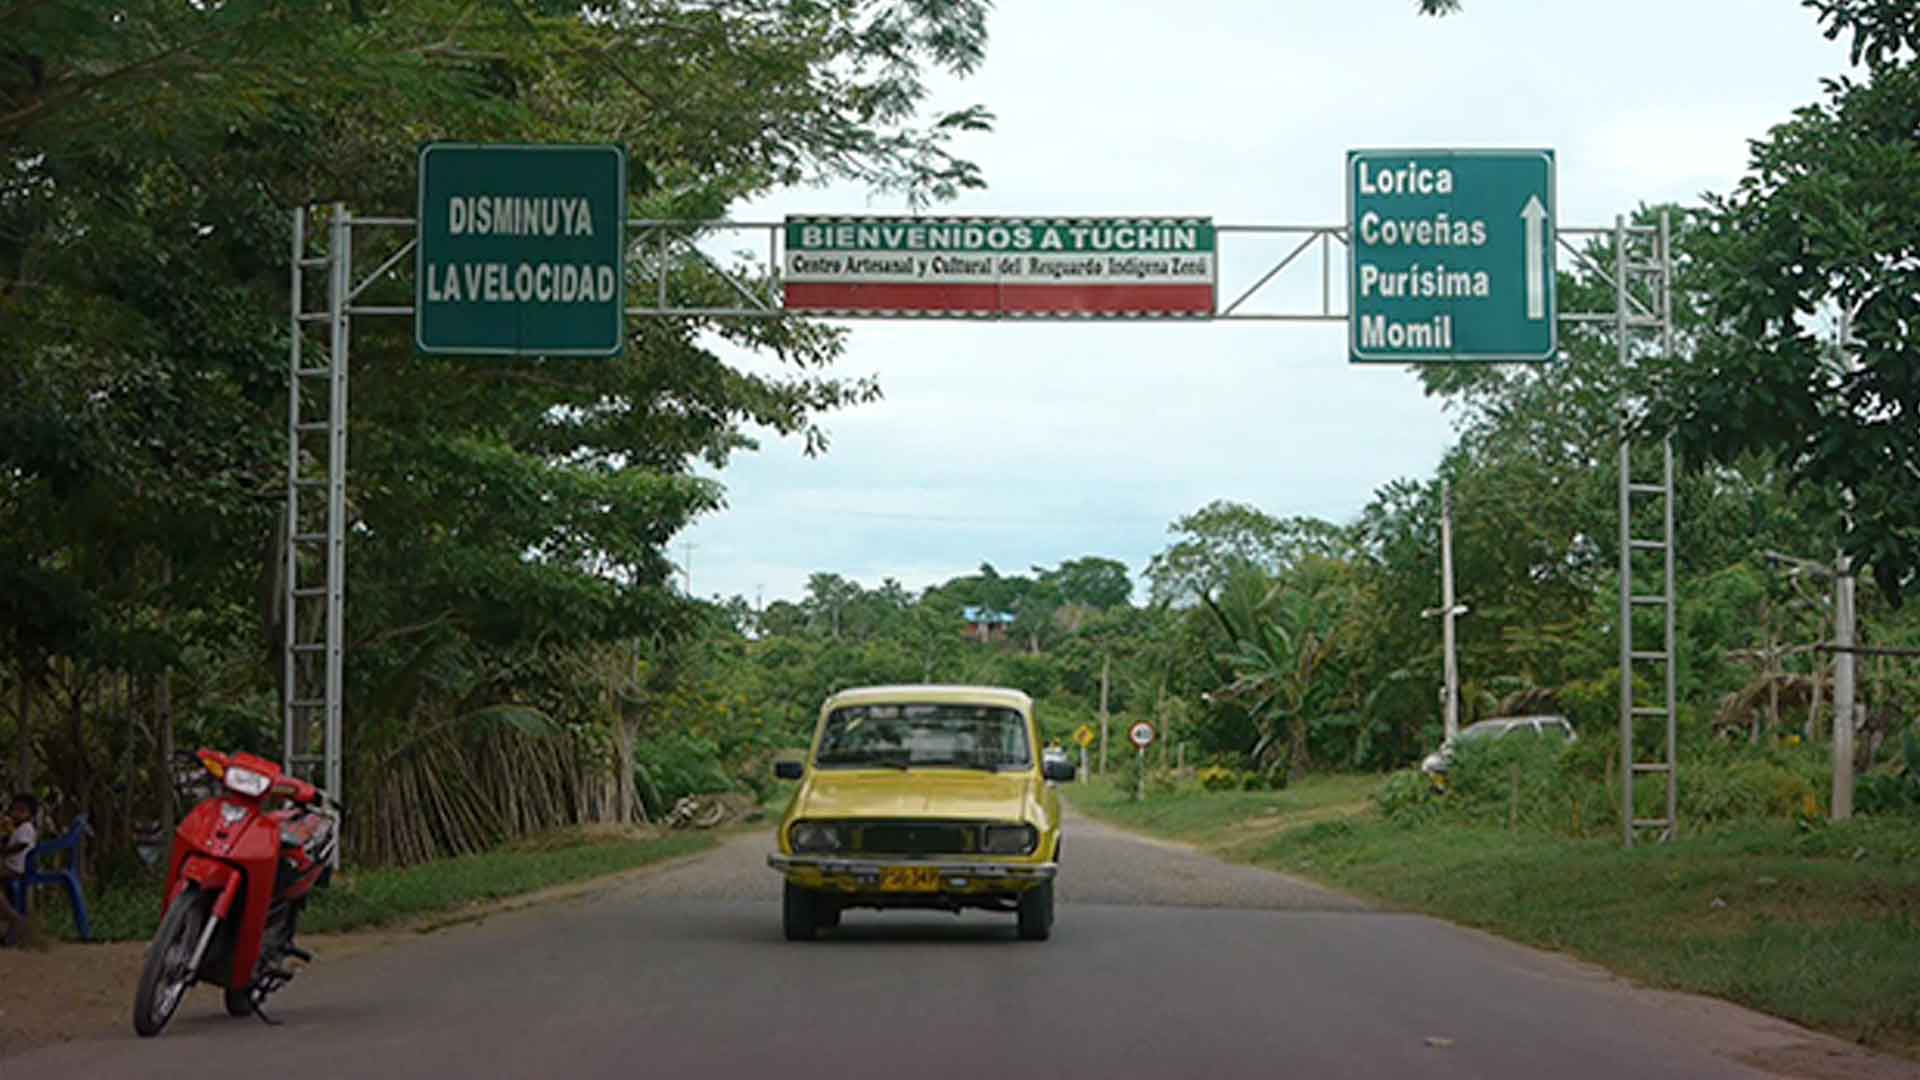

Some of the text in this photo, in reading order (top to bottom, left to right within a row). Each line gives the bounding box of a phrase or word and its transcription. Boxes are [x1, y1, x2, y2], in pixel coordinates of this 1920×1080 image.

[1359, 162, 1453, 194] Lorica
[450, 196, 593, 236] DISMINUYA
[1360, 211, 1487, 246] Coveñas
[803, 226, 1196, 249] BIENVENIDOS A TUCHIN
[427, 262, 615, 302] LA VELOCIDAD
[793, 254, 842, 274] Centro
[846, 256, 914, 274] Artesanal
[917, 260, 926, 277] y
[932, 255, 991, 274] Cultural
[999, 257, 1022, 275] del
[1360, 263, 1489, 297] Purísima
[1360, 315, 1451, 349] Momil
